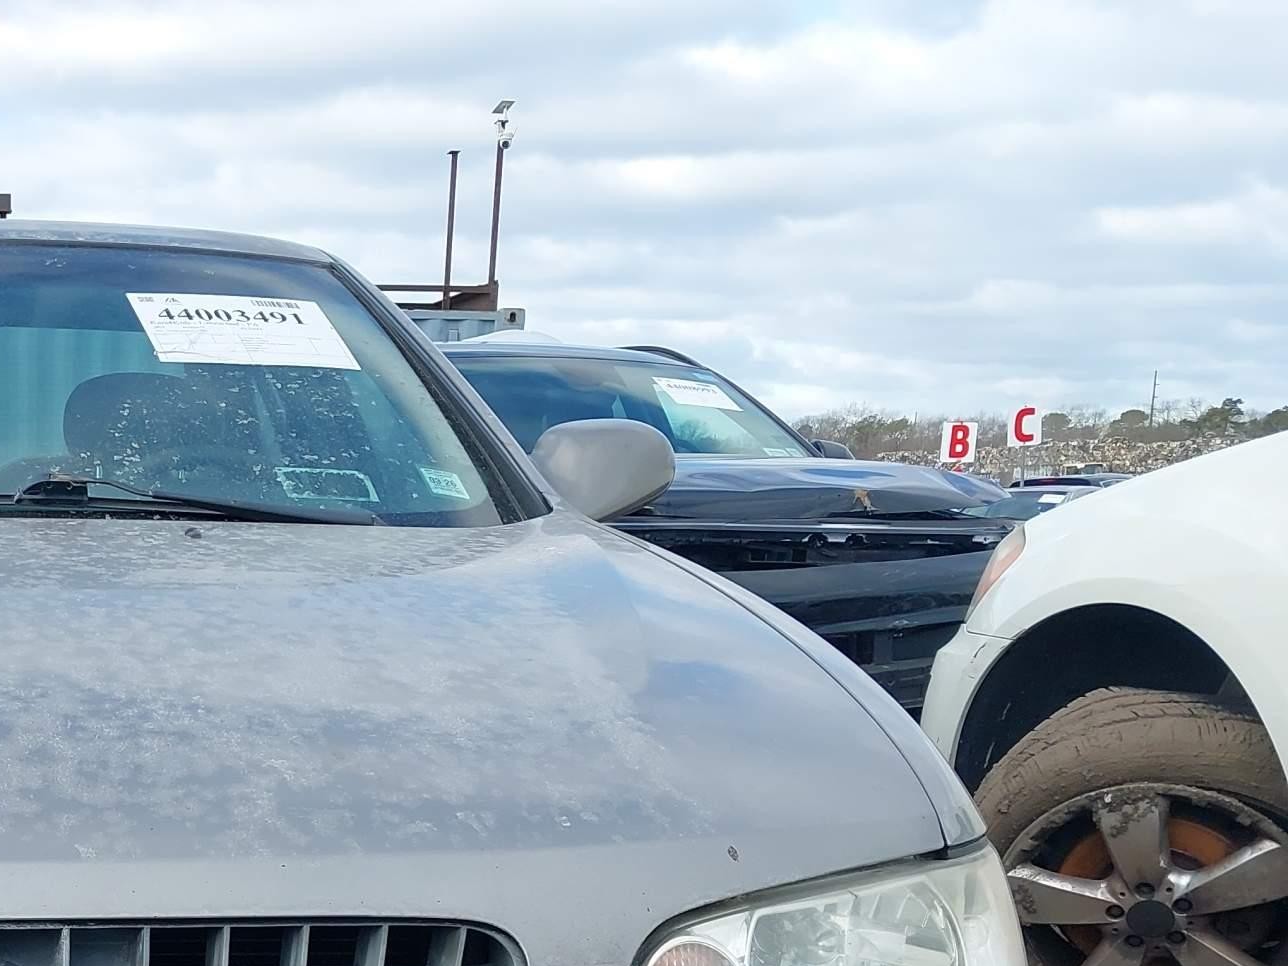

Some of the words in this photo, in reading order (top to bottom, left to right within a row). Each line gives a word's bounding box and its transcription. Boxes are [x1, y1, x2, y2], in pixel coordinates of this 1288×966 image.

[158, 307, 306, 325] 44003491
[949, 425, 969, 458] B
[1015, 408, 1035, 442] C
